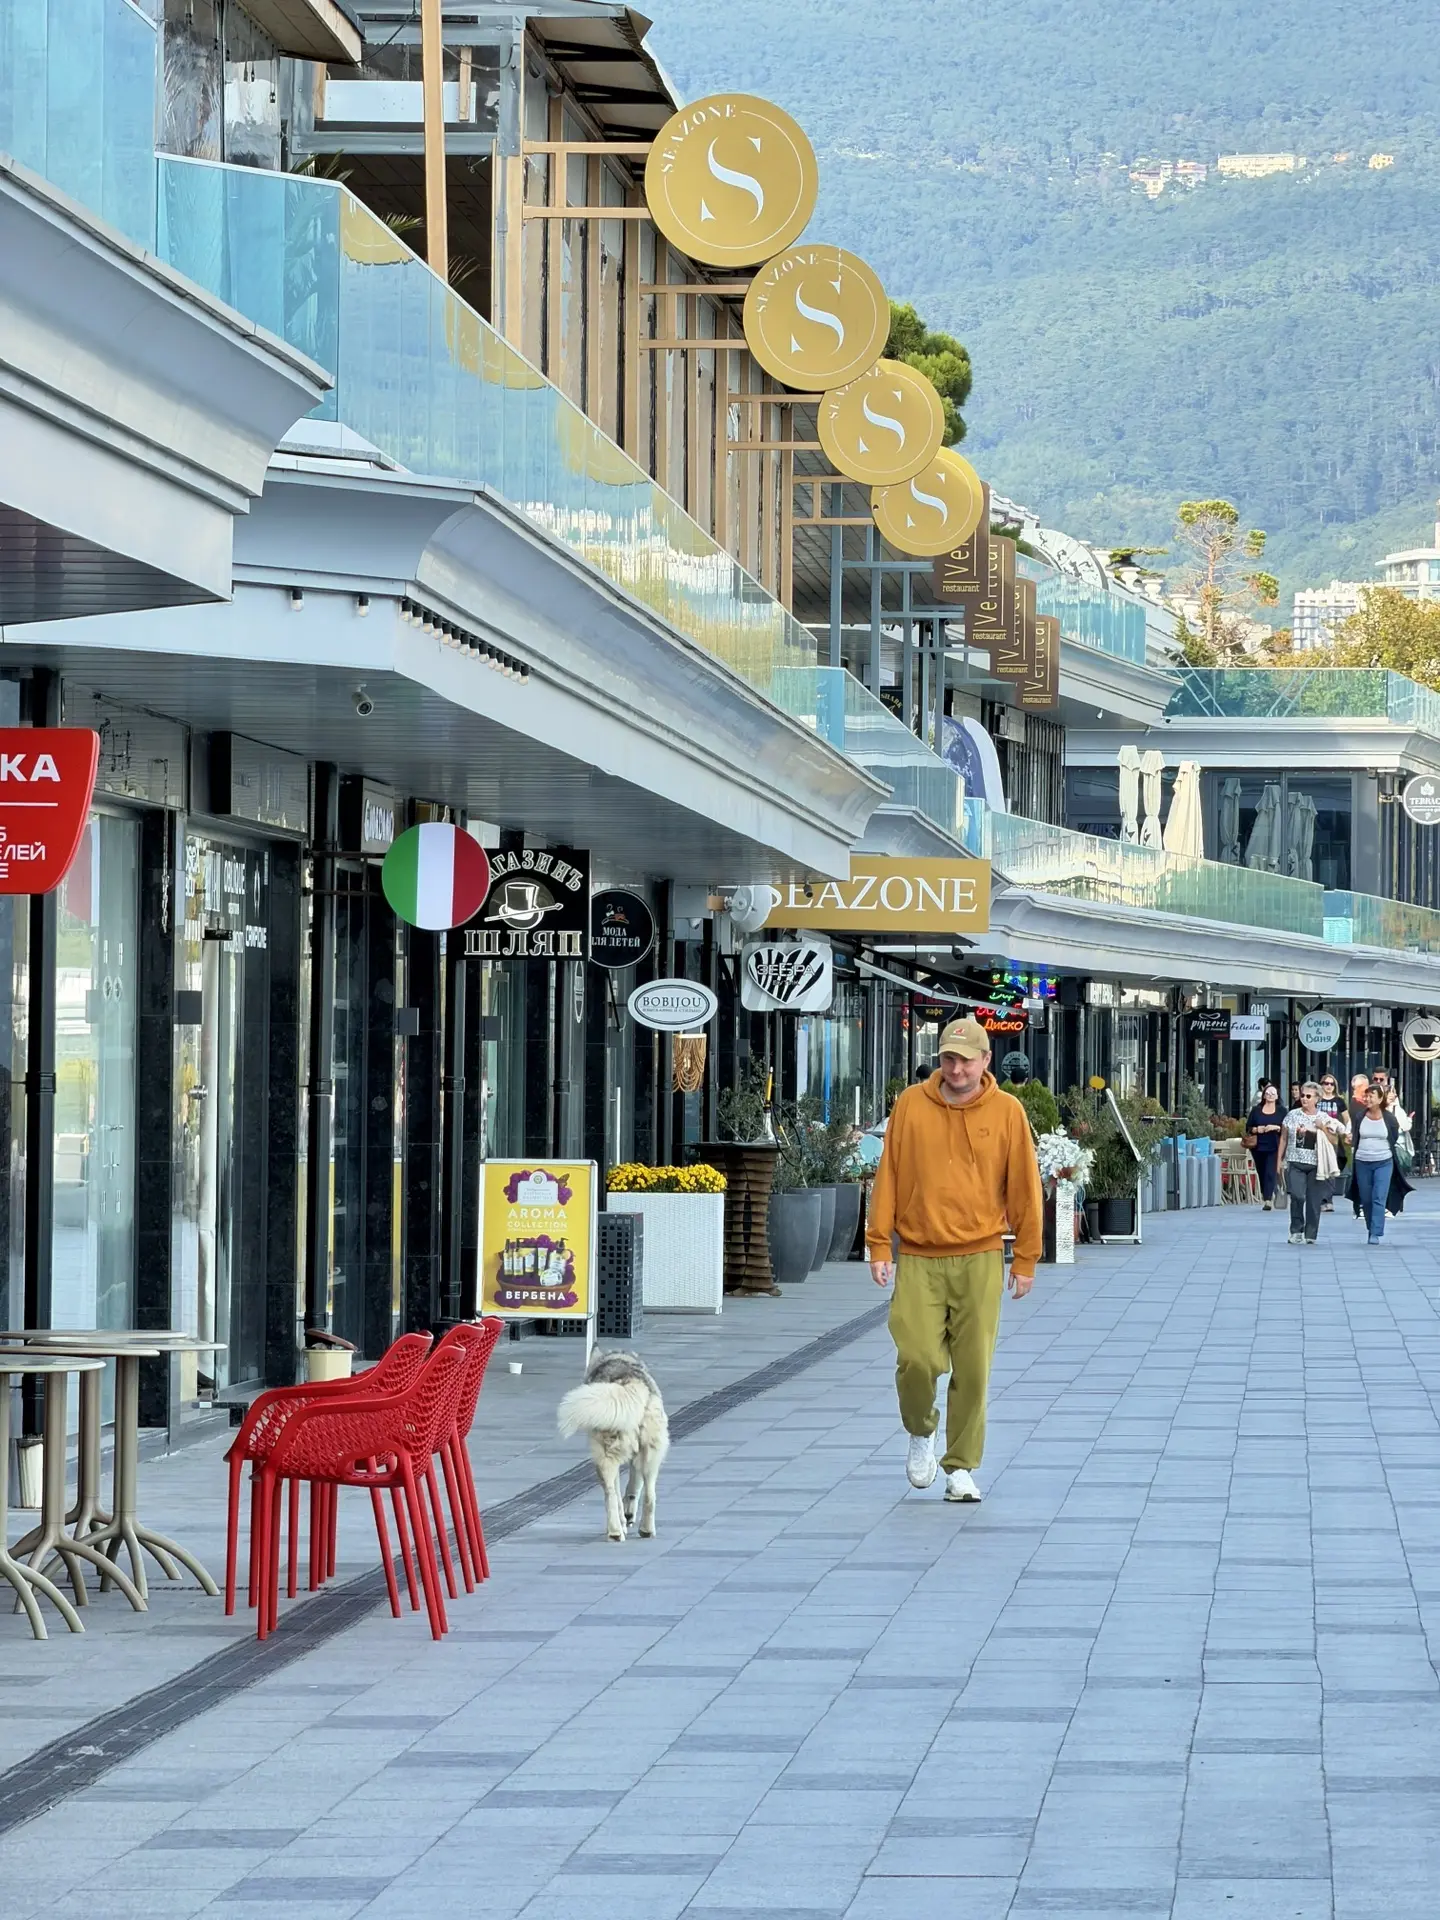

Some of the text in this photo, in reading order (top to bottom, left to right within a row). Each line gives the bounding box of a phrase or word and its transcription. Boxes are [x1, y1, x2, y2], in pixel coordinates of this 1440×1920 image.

[661, 103, 736, 173] SEAZONE
[757, 253, 819, 313] SEAZONE
[942, 583, 980, 593] restaurant
[972, 631, 1007, 641] restaurant
[996, 665, 1028, 674] restaurant
[1022, 695, 1052, 704] restaurant
[490, 850, 584, 891] АГАЗИНЪ
[602, 927, 627, 937] МОДА
[464, 929, 583, 956] ШЛЯП
[608, 936, 641, 948] ДЕТЕЙ
[757, 962, 816, 977] ЗЕБРА
[643, 996, 702, 1009] BOBIJOU
[508, 1208, 568, 1219] AROMA
[507, 1220, 568, 1229] COLLECTION
[505, 1290, 566, 1301] ВЕРБЕНА
